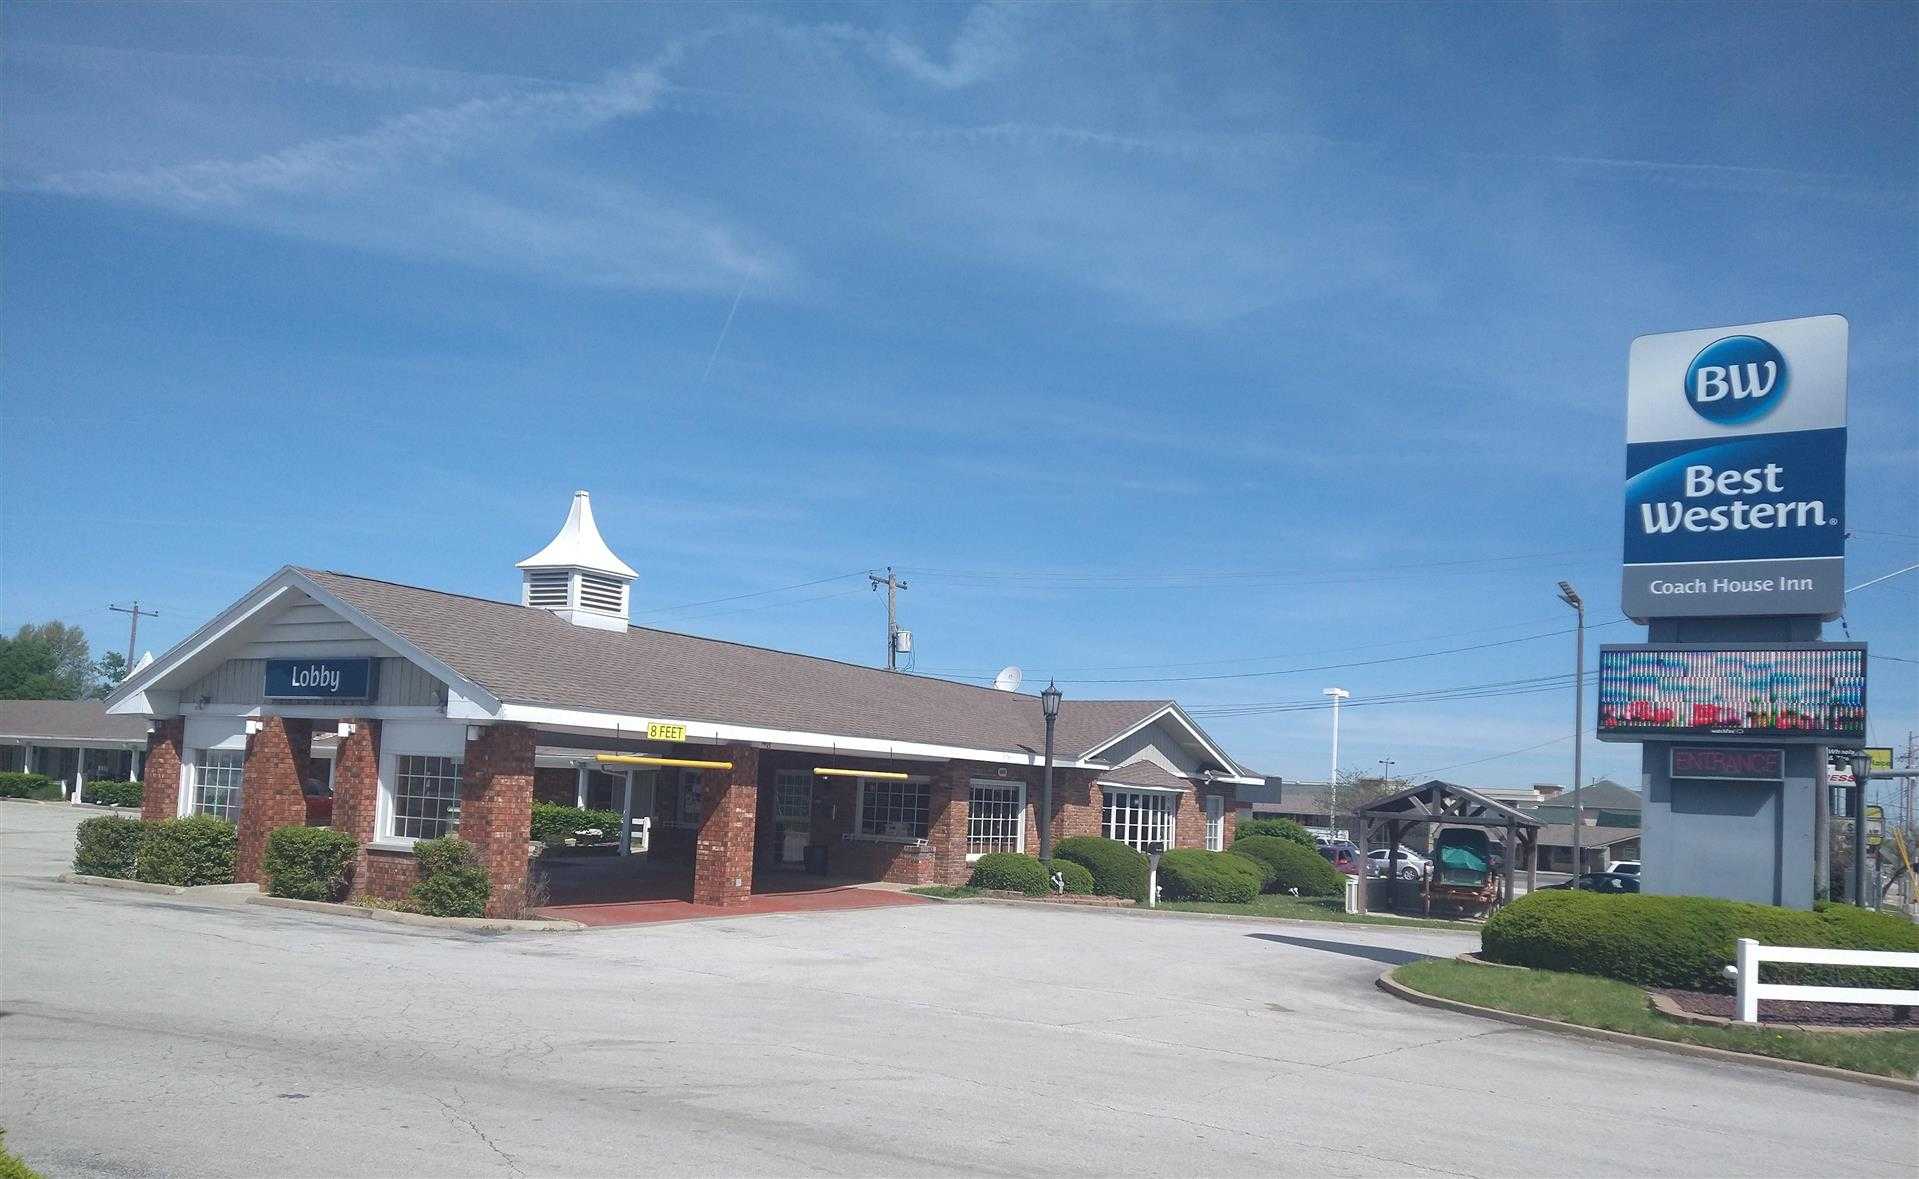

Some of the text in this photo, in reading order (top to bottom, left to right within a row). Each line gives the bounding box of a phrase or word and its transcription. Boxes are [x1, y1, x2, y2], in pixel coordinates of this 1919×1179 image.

[1696, 360, 1777, 402] BW
[1685, 463, 1785, 498] Best
[1640, 499, 1827, 534] Western
[1650, 575, 1814, 595] Coach House Inn
[292, 664, 340, 692] Lobby
[650, 725, 684, 739] 8 FEET
[1676, 751, 1778, 776] ENTRANCE
